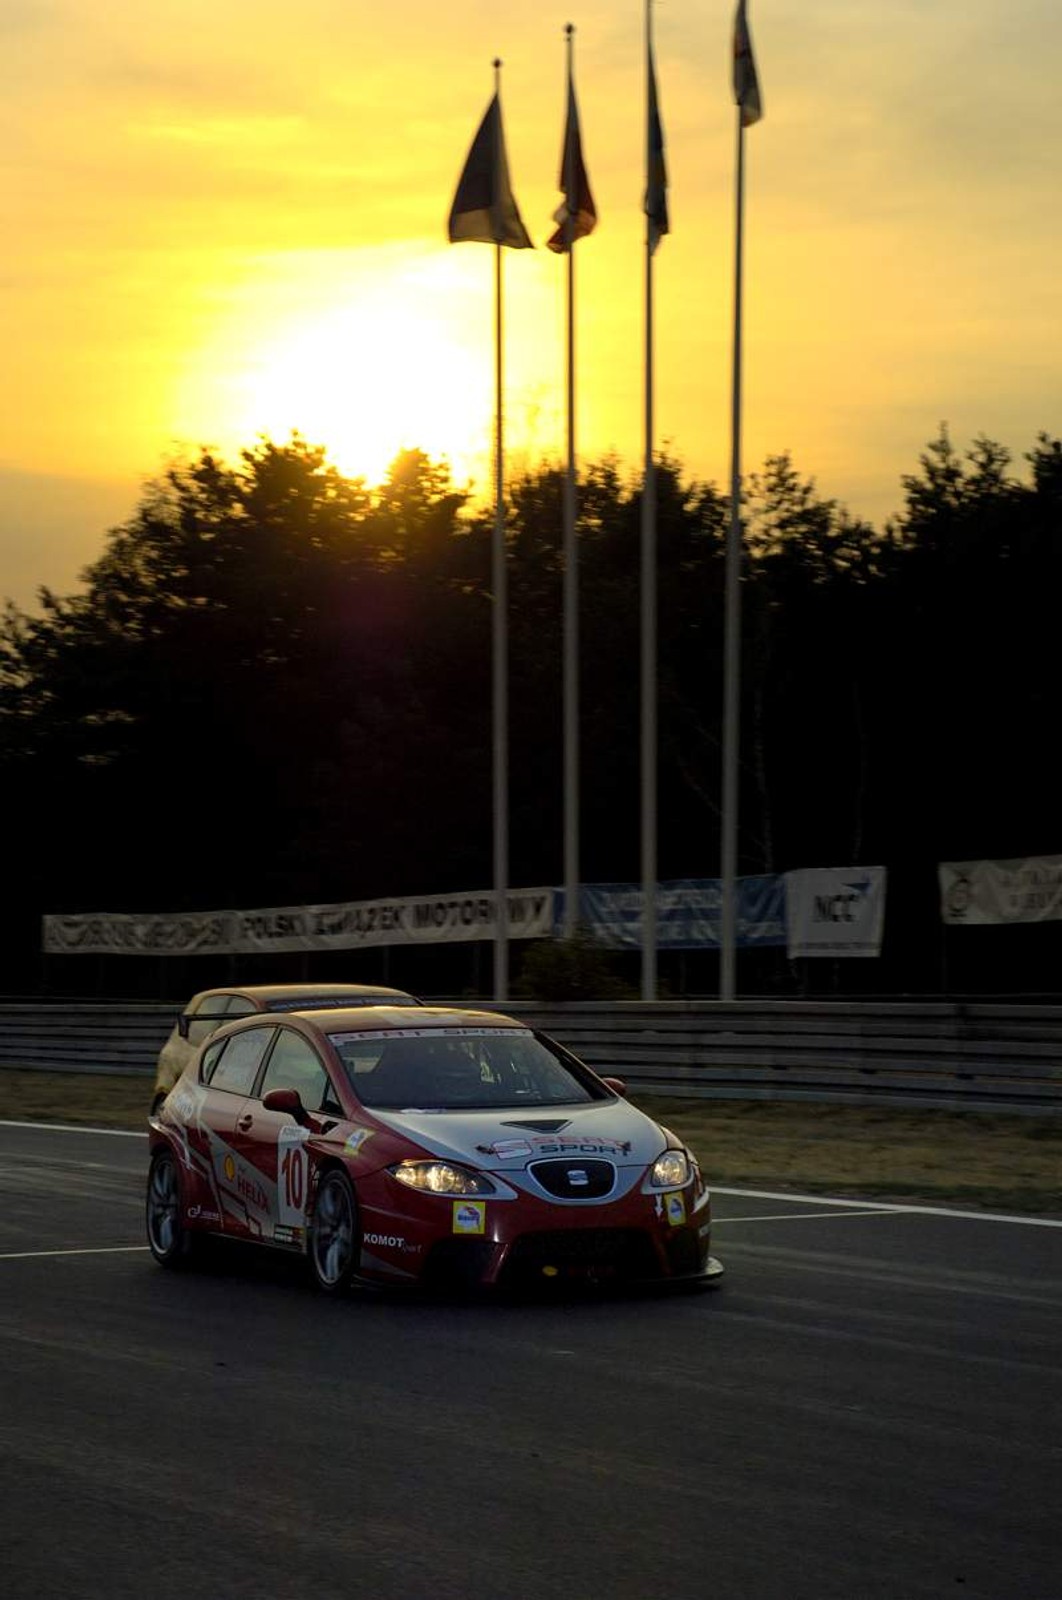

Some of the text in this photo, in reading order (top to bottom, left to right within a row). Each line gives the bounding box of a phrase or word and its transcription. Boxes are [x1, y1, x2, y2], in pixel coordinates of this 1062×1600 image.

[411, 895, 546, 928] MOTORWY
[813, 893, 861, 923] NCC
[540, 1143, 628, 1157] SPORT
[281, 1147, 303, 1210] 10
